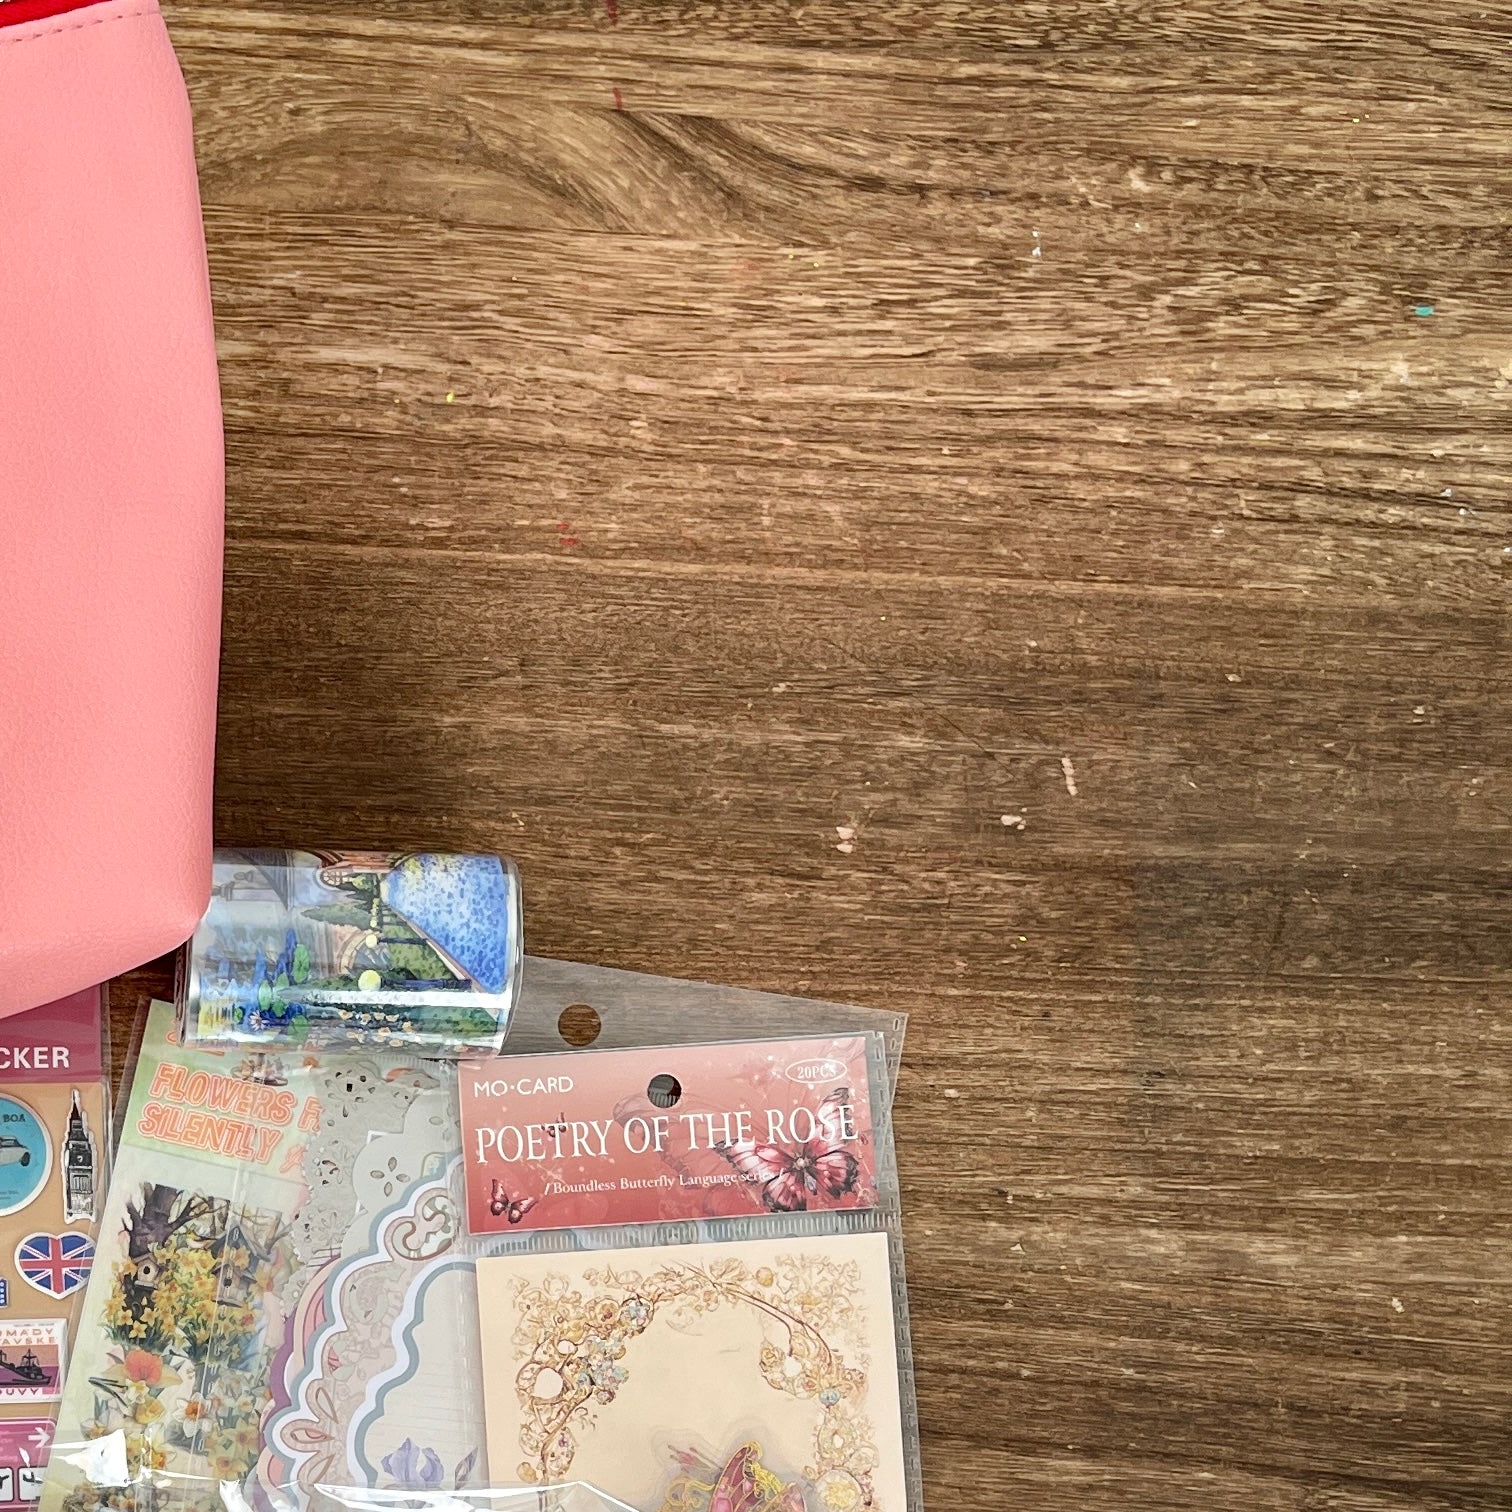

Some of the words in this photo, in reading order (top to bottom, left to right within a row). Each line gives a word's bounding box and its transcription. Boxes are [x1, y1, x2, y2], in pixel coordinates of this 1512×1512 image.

[3, 1114, 26, 1124] BOA
[149, 1062, 298, 1126] FLOWERS
[137, 1102, 282, 1165] SILENTLY
[475, 1119, 613, 1164] POETRY
[623, 1115, 672, 1153] OF
[679, 1111, 756, 1150] THE
[764, 1103, 860, 1144] ROSE
[553, 1179, 616, 1195] Boundless
[620, 1175, 675, 1191] Butterfly
[678, 1173, 739, 1190] Language
